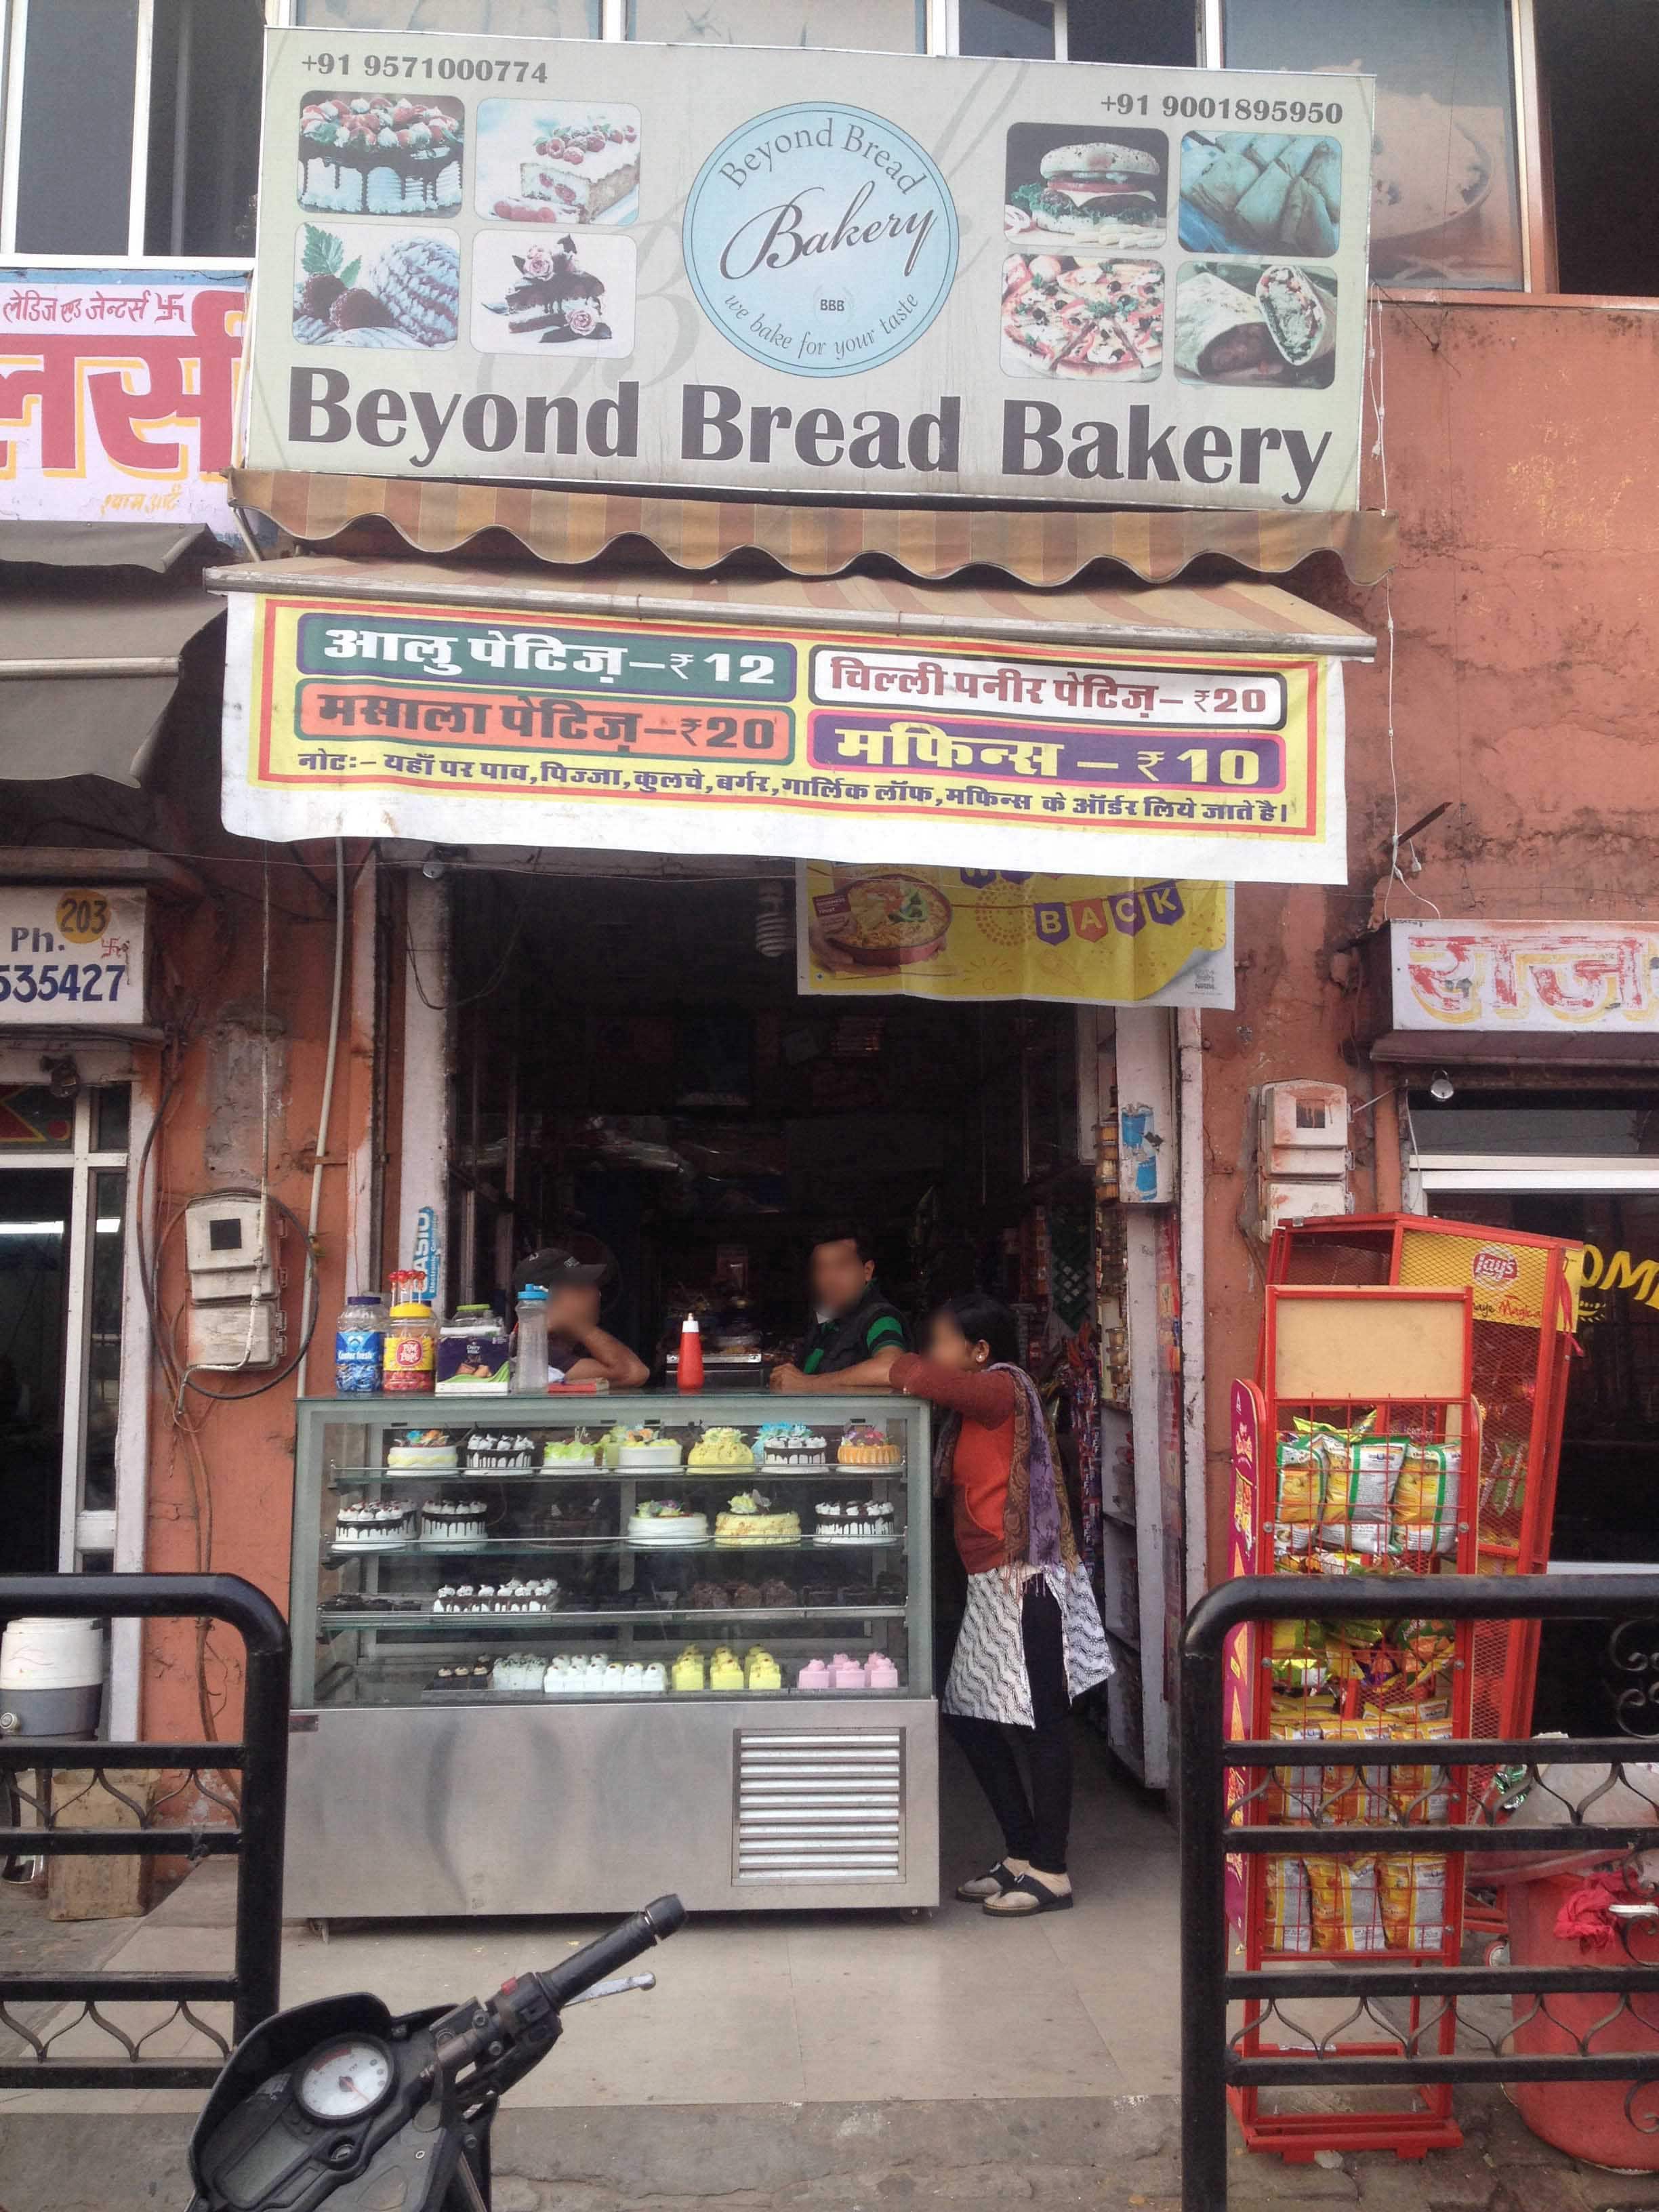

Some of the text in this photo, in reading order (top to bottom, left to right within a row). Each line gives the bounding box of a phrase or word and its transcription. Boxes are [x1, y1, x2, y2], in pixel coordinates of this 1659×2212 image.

[302, 53, 549, 84] +91 9571000774
[1101, 94, 1344, 125] +91 9001895950
[718, 118, 928, 195] Beyond Bread
[720, 180, 938, 280] Bakery
[724, 293, 919, 361] we bake for your taste
[820, 300, 845, 312] BBB
[288, 365, 1334, 506] Beyond Bread Bakery
[952, 668, 1047, 705] पनीर
[317, 693, 493, 735] मसाला
[834, 720, 1065, 778] मफिन्स
[439, 759, 474, 779] पर
[1041, 792, 1066, 812] के
[1143, 796, 1198, 819] लिये
[1200, 800, 1256, 821] जाते
[60, 897, 108, 934] 203
[1040, 885, 1177, 934] BACK
[11, 926, 66, 953] Ph.
